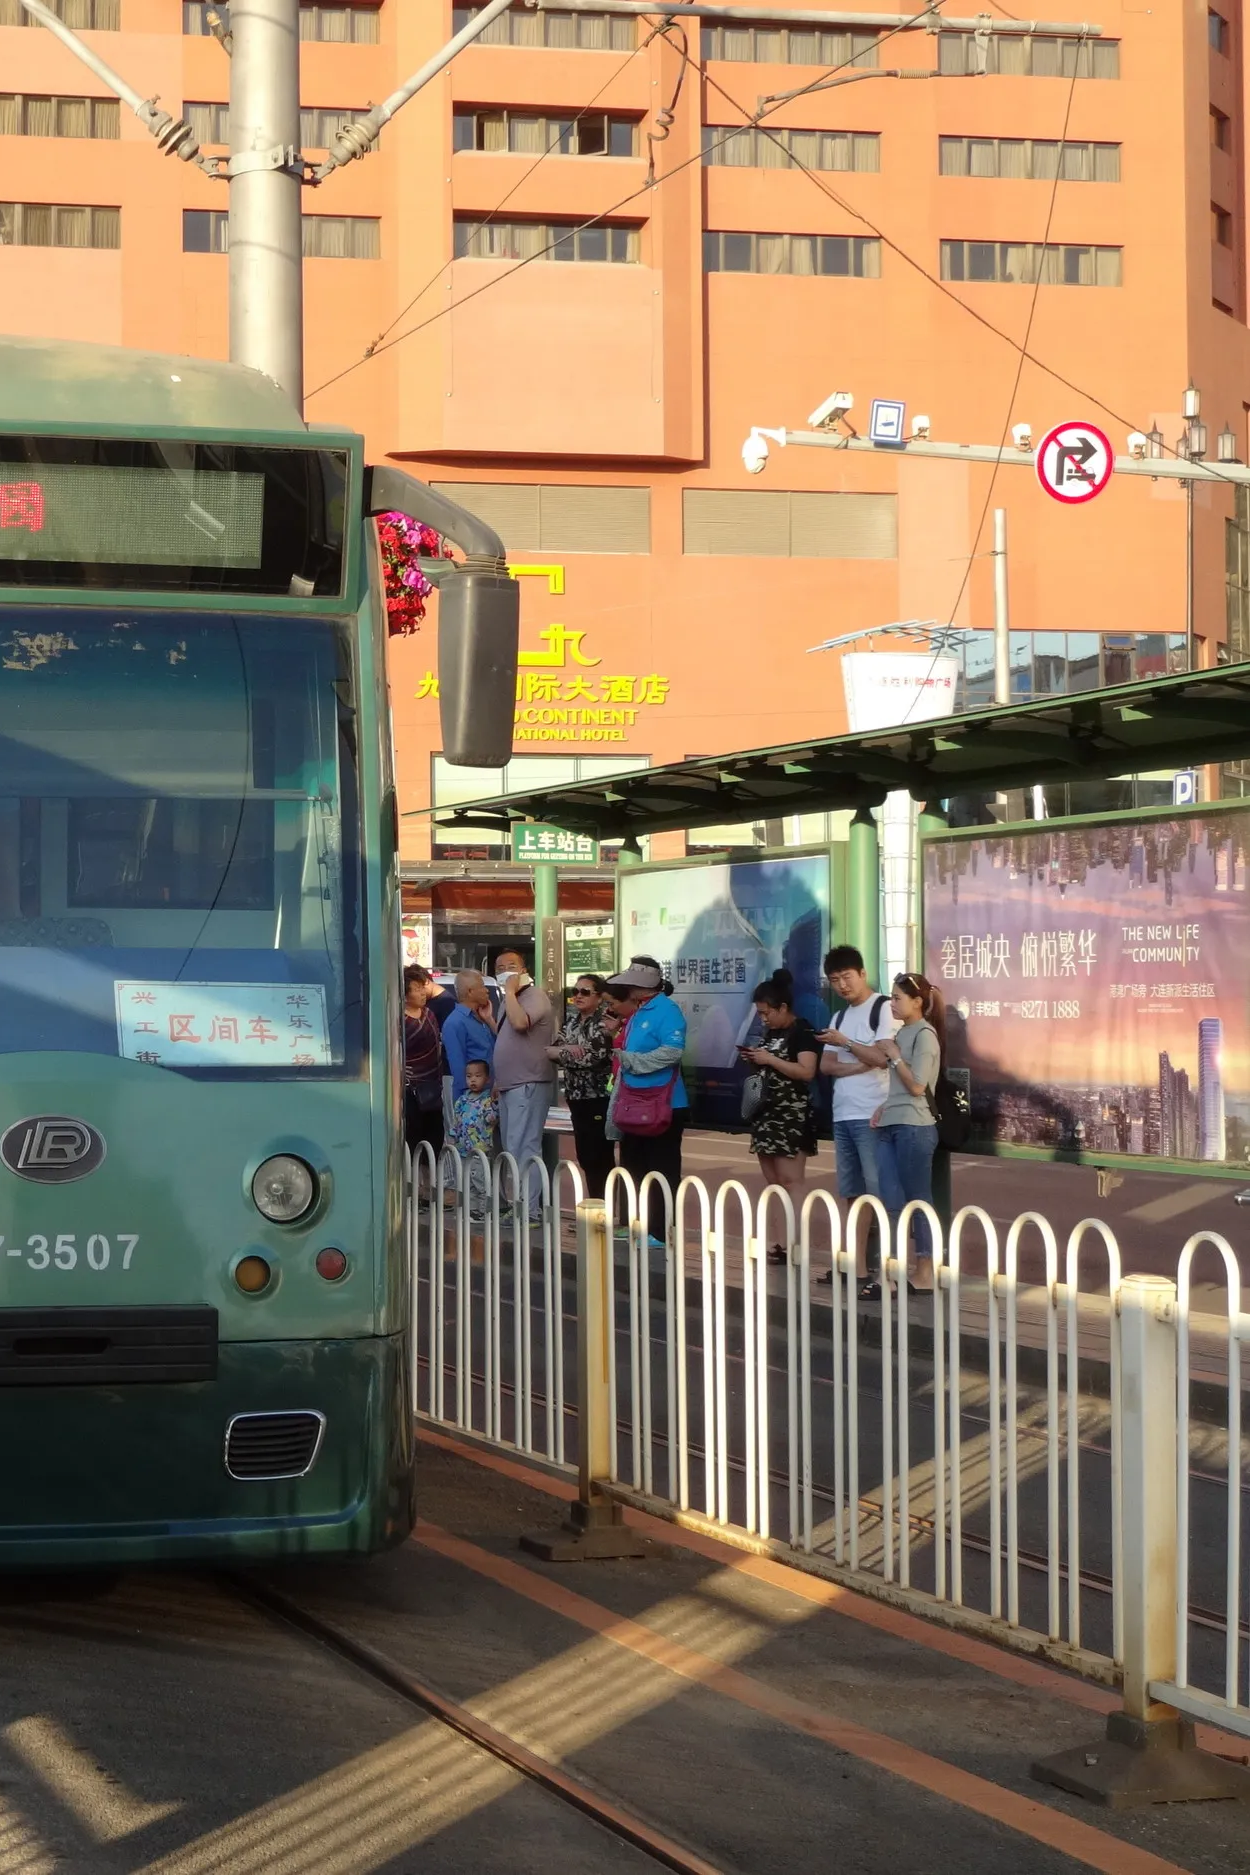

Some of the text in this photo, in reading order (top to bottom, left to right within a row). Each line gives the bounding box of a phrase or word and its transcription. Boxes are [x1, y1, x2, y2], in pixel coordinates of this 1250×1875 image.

[414, 671, 670, 705] 九际大酒店
[522, 707, 639, 726] CONTINENT
[580, 728, 629, 742] HOTEL
[519, 830, 593, 852] 上车站台
[1122, 926, 1144, 941] THE
[1147, 925, 1172, 941] NEW
[941, 928, 1097, 979] 奢居城央 俯悦繁华
[1132, 946, 1200, 965] COMMUNITY
[1021, 1000, 1049, 1019] 8271
[1051, 999, 1080, 1019] 1888
[131, 991, 161, 1065] 兴工街
[169, 1014, 279, 1045] 区间车
[286, 993, 316, 1067] 华乐广场
